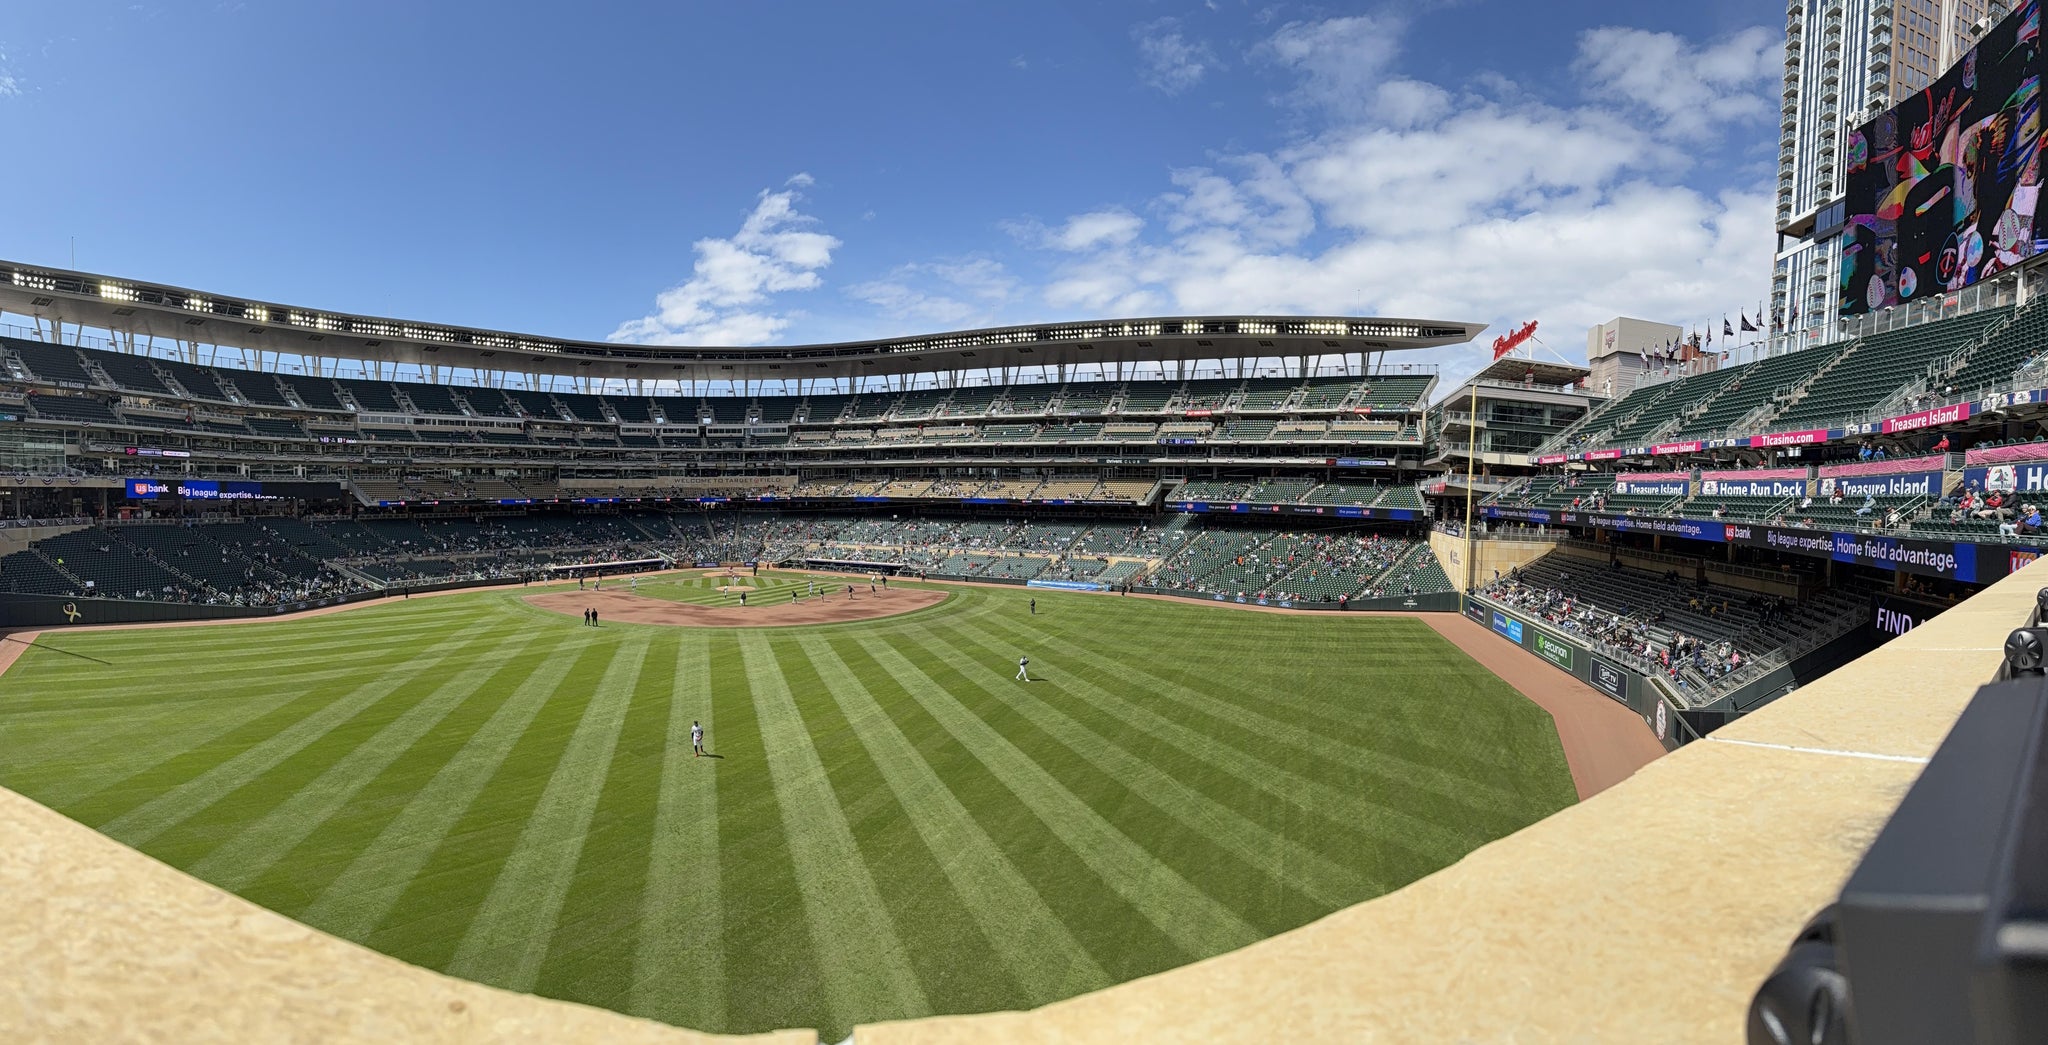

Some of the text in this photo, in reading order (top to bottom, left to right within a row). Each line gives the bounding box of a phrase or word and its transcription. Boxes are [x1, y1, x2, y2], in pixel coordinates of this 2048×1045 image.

[1890, 406, 1959, 432] Treasure Island
[1762, 434, 1814, 446] TIcasino.com
[1656, 442, 1696, 454] Treasure Island
[148, 484, 169, 493] bank
[178, 487, 190, 497] Big
[192, 487, 218, 498] league
[1630, 483, 1684, 495] Treasure Island
[1720, 481, 1802, 496] Home Run Deck
[1841, 476, 1929, 495] Treasure Island
[1611, 518, 1636, 528] expertise.
[1636, 519, 1652, 529] Home
[1653, 520, 1666, 530] field
[1666, 522, 1702, 536] advantage.
[1735, 527, 1751, 539] bank
[1767, 530, 1958, 573] Big league expertise. Home field advantage.
[1877, 608, 1912, 635] FIND
[1544, 640, 1567, 659] securian
